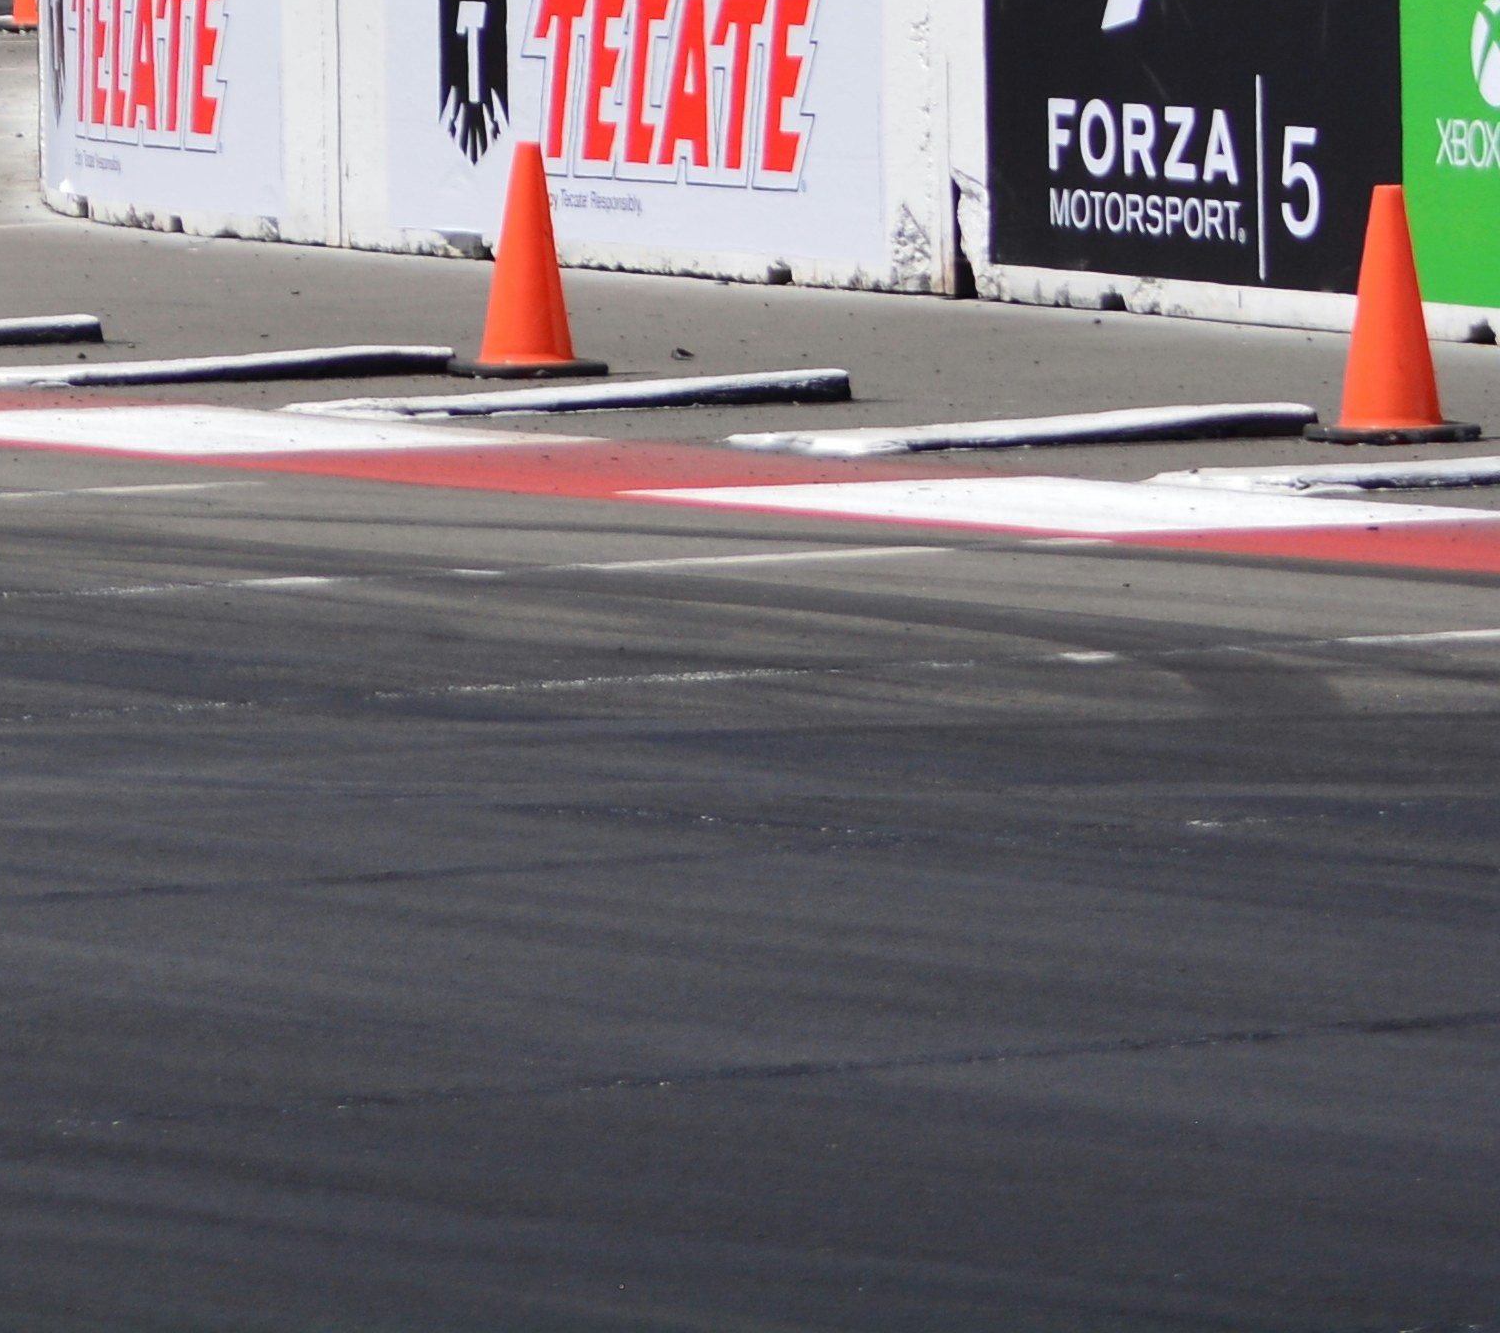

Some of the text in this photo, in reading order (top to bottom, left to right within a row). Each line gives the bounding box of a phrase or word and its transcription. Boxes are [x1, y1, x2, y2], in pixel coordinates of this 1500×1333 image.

[1047, 97, 1320, 237] FORZA 5
[1436, 117, 1500, 171] XBOX
[1049, 187, 1242, 241] MOTORSPORT
